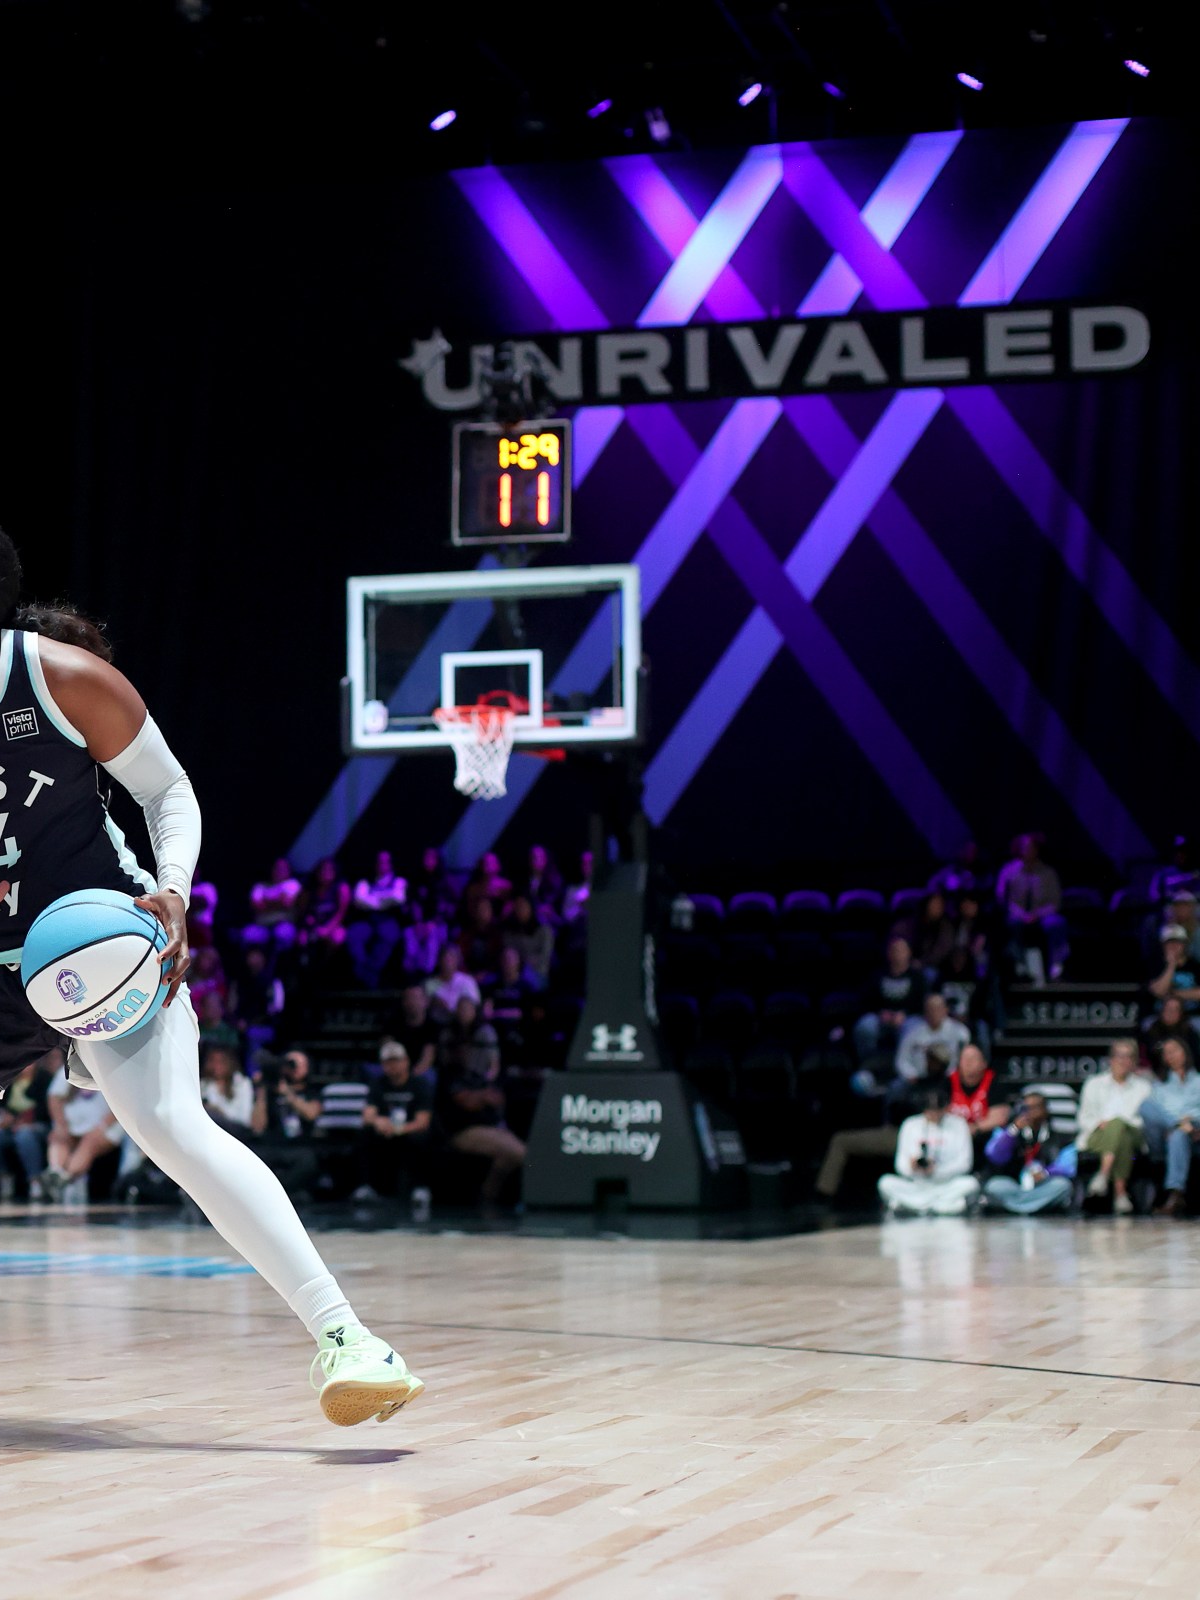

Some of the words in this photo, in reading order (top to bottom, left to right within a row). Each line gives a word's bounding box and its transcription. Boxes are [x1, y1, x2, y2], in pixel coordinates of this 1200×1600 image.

[423, 305, 1151, 411] UNRIVALED
[498, 432, 560, 471] 1:29
[499, 471, 551, 529] 11
[6, 712, 33, 725] vista
[9, 721, 35, 737] print
[57, 988, 150, 1037] Wilson
[94, 1007, 109, 1019] EVO
[560, 1094, 663, 1128] Morgan
[560, 1125, 661, 1162] Stanley
